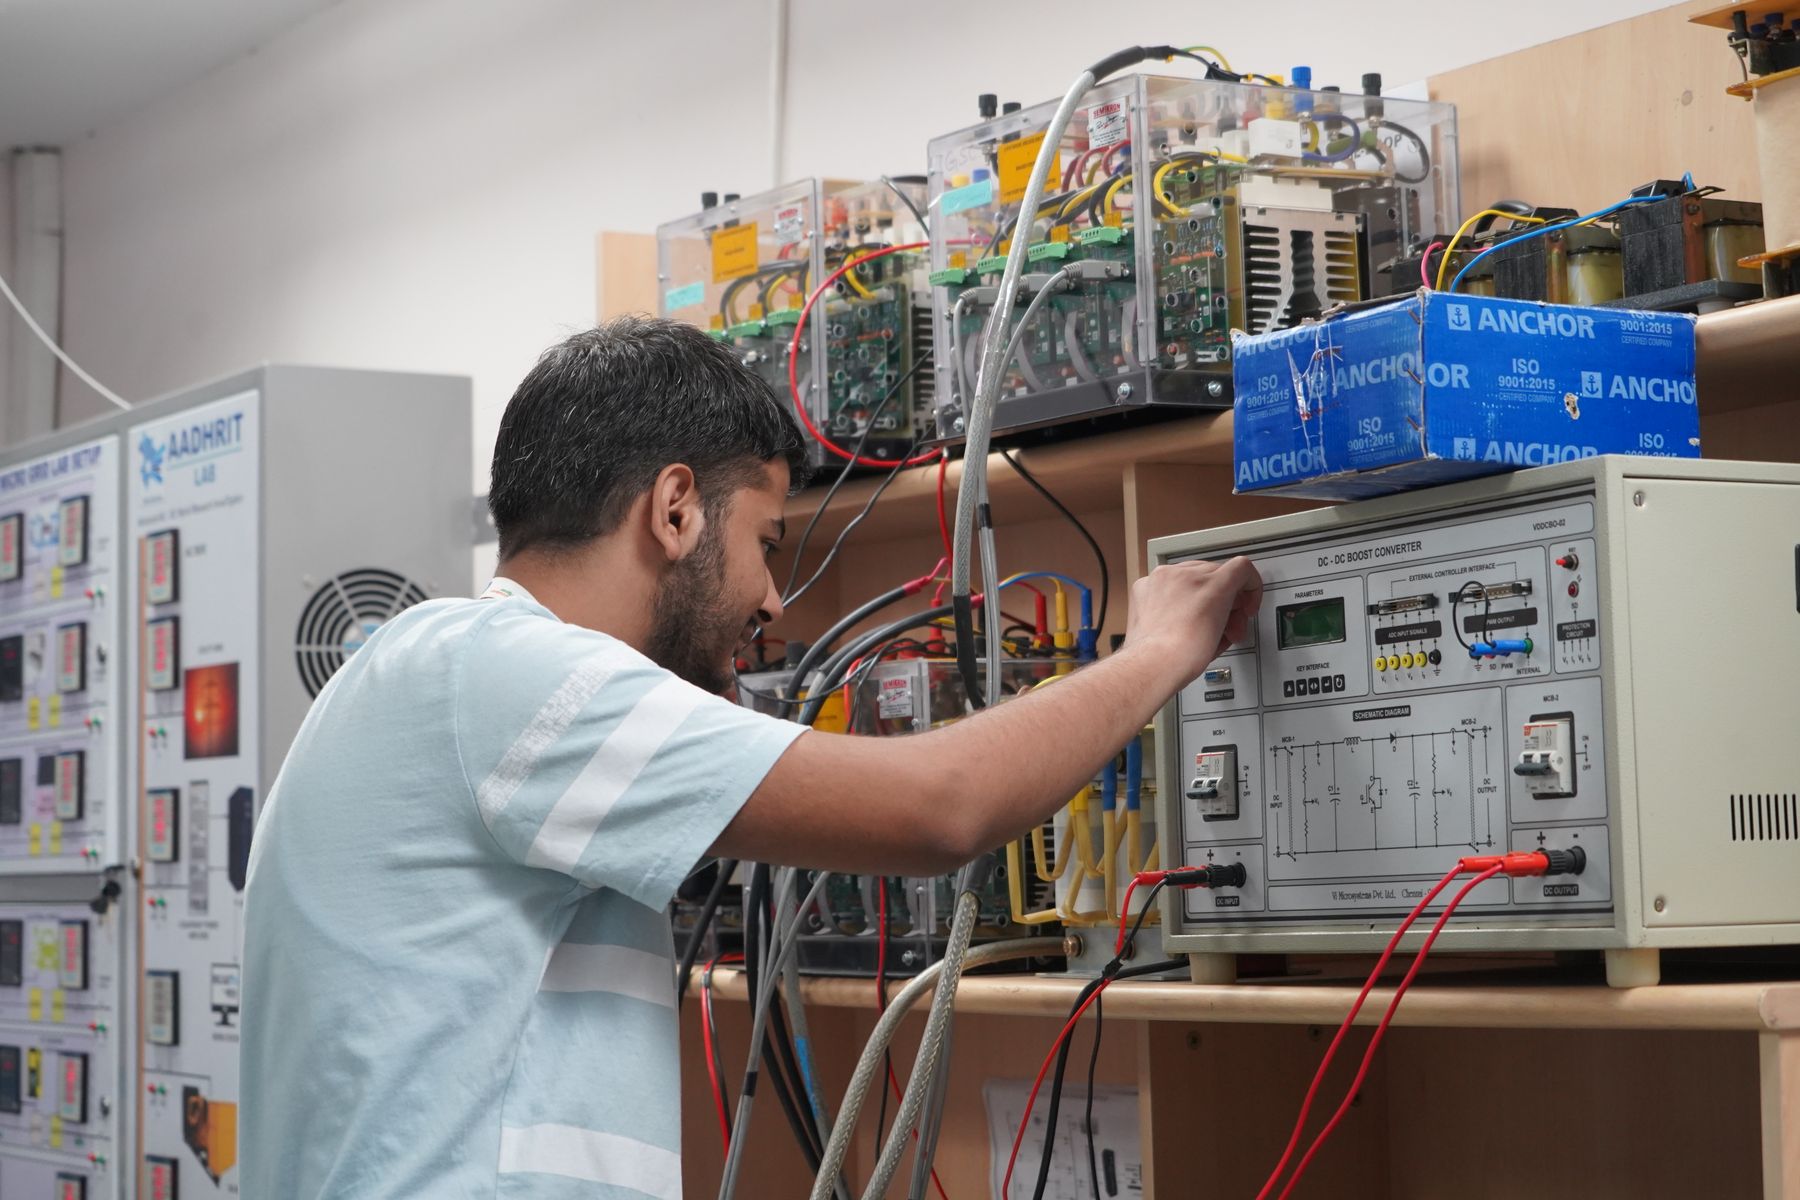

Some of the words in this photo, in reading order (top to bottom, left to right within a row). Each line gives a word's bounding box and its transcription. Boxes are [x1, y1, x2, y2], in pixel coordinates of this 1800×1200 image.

[1478, 307, 1596, 339] ANCHOR
[1620, 319, 1673, 335] 9001:2015
[1621, 335, 1648, 346] CERTIFIED
[1648, 338, 1672, 348] COMPANY
[1512, 358, 1540, 375] ISO
[1258, 374, 1278, 393] ISO
[1428, 362, 1471, 389] OR
[1498, 375, 1556, 390] 9001:2015
[1246, 388, 1290, 408] 9001:2015
[1609, 376, 1697, 405] ANCHO
[1359, 416, 1382, 435] ISO
[168, 412, 243, 460] AADHRIT
[1347, 432, 1396, 452] 9001:2015
[1639, 432, 1665, 449] ISO
[194, 464, 216, 486] LAB
[1317, 556, 1329, 567] DC
[1334, 553, 1346, 565] DC
[1347, 548, 1374, 563] BOOST
[1374, 540, 1422, 558] CONVERTER
[1408, 573, 1434, 582] EXTERNAL
[1434, 566, 1468, 578] CONTROLLER
[1468, 562, 1496, 573] INTERFACE
[1294, 588, 1324, 599] PARAMETERS
[1409, 627, 1428, 636] SIGNALS
[1561, 622, 1591, 632] PROTECTION
[1296, 664, 1306, 672] KEY
[1306, 662, 1330, 671] INTERFACE
[1516, 666, 1541, 675] INTERNAL
[1354, 709, 1385, 720] SCHEMATIC
[1384, 706, 1410, 717] DIAGRAM
[1477, 785, 1498, 794] OUTPUT
[1544, 886, 1553, 895] DC
[1553, 885, 1578, 895] OUTPUT
